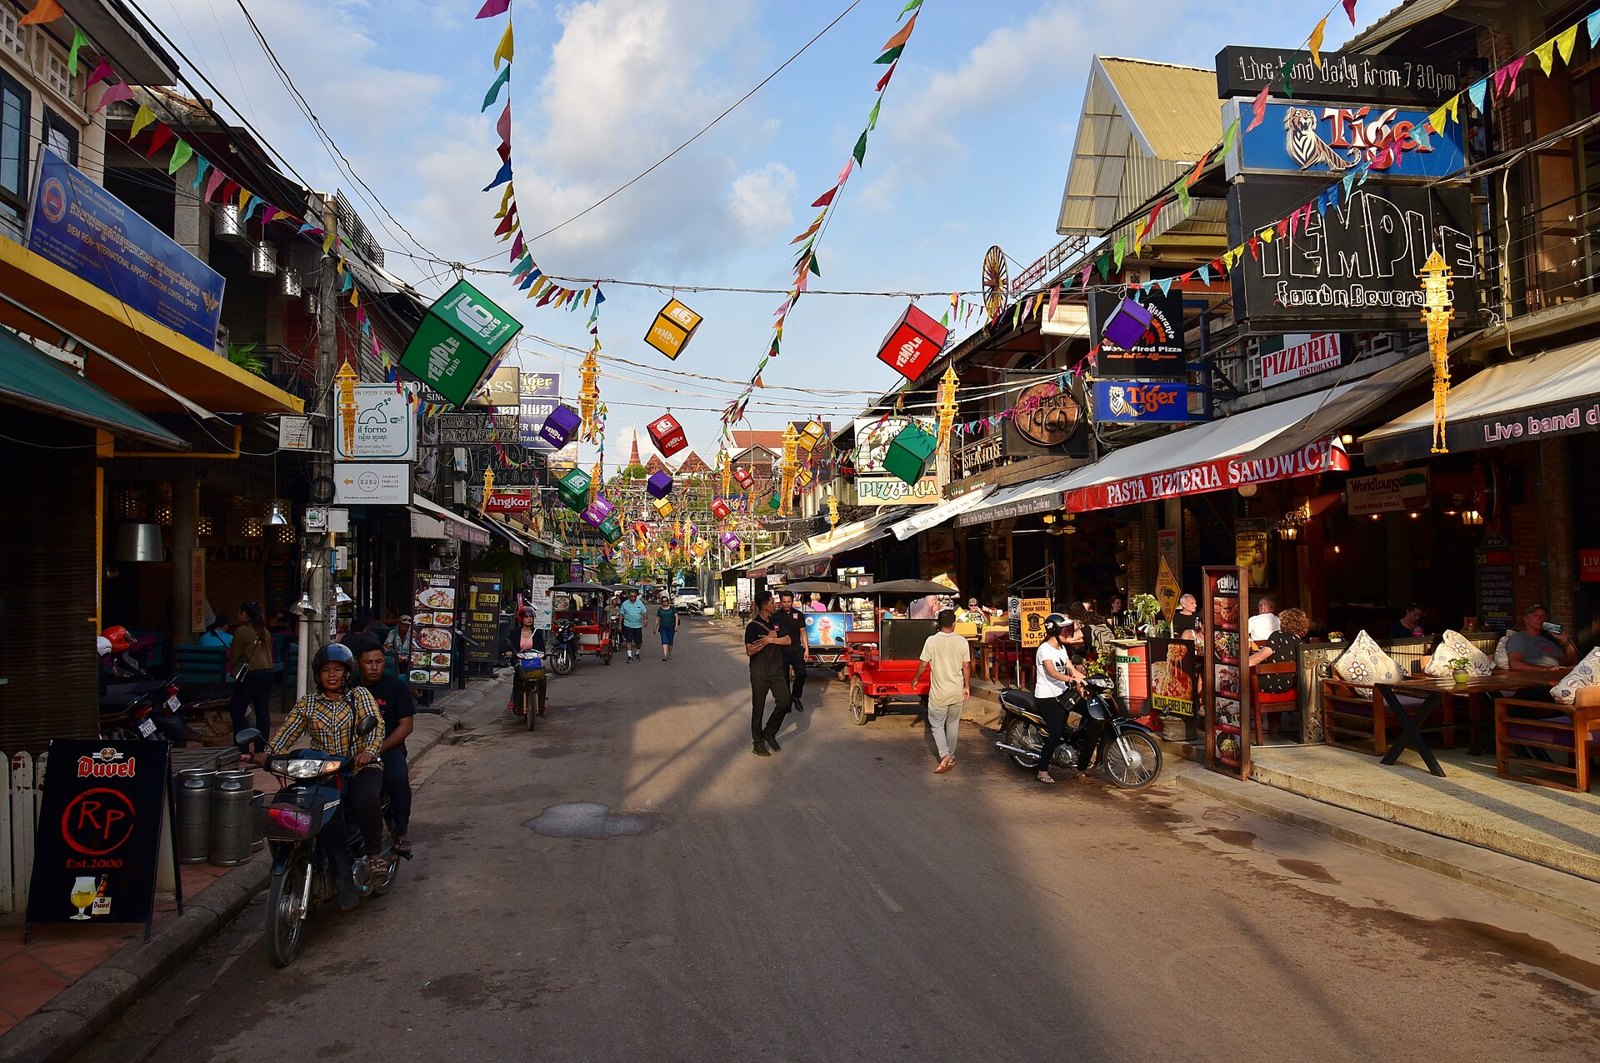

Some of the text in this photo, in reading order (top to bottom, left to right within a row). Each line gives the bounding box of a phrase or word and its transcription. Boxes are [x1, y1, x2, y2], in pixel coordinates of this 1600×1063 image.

[1239, 55, 1274, 82] Live
[1321, 56, 1358, 88] daily
[1361, 58, 1400, 87] from
[1254, 189, 1476, 279] TEMPLE
[449, 295, 495, 333] 16
[1146, 302, 1175, 340] Ristorante
[654, 327, 679, 347] TEMPLE
[1158, 345, 1183, 353] Pizza
[427, 336, 460, 382] TEMPLE
[896, 336, 923, 367] TEMPLE
[1262, 332, 1340, 379] PIZZERIA
[445, 358, 460, 377] Club
[1299, 358, 1340, 377] RISTORANTE
[1127, 385, 1177, 412] Tiger
[364, 425, 388, 434] forno
[1027, 407, 1067, 432] 1960
[1484, 422, 1523, 442] Live
[1528, 408, 1580, 435] band
[859, 480, 938, 499] PIZZERIA
[1106, 480, 1147, 505] PASTA
[1151, 464, 1222, 497] PIZZERIA
[488, 495, 530, 508] Angkor
[77, 756, 136, 778] Duvel
[93, 901, 110, 909] Duvel
